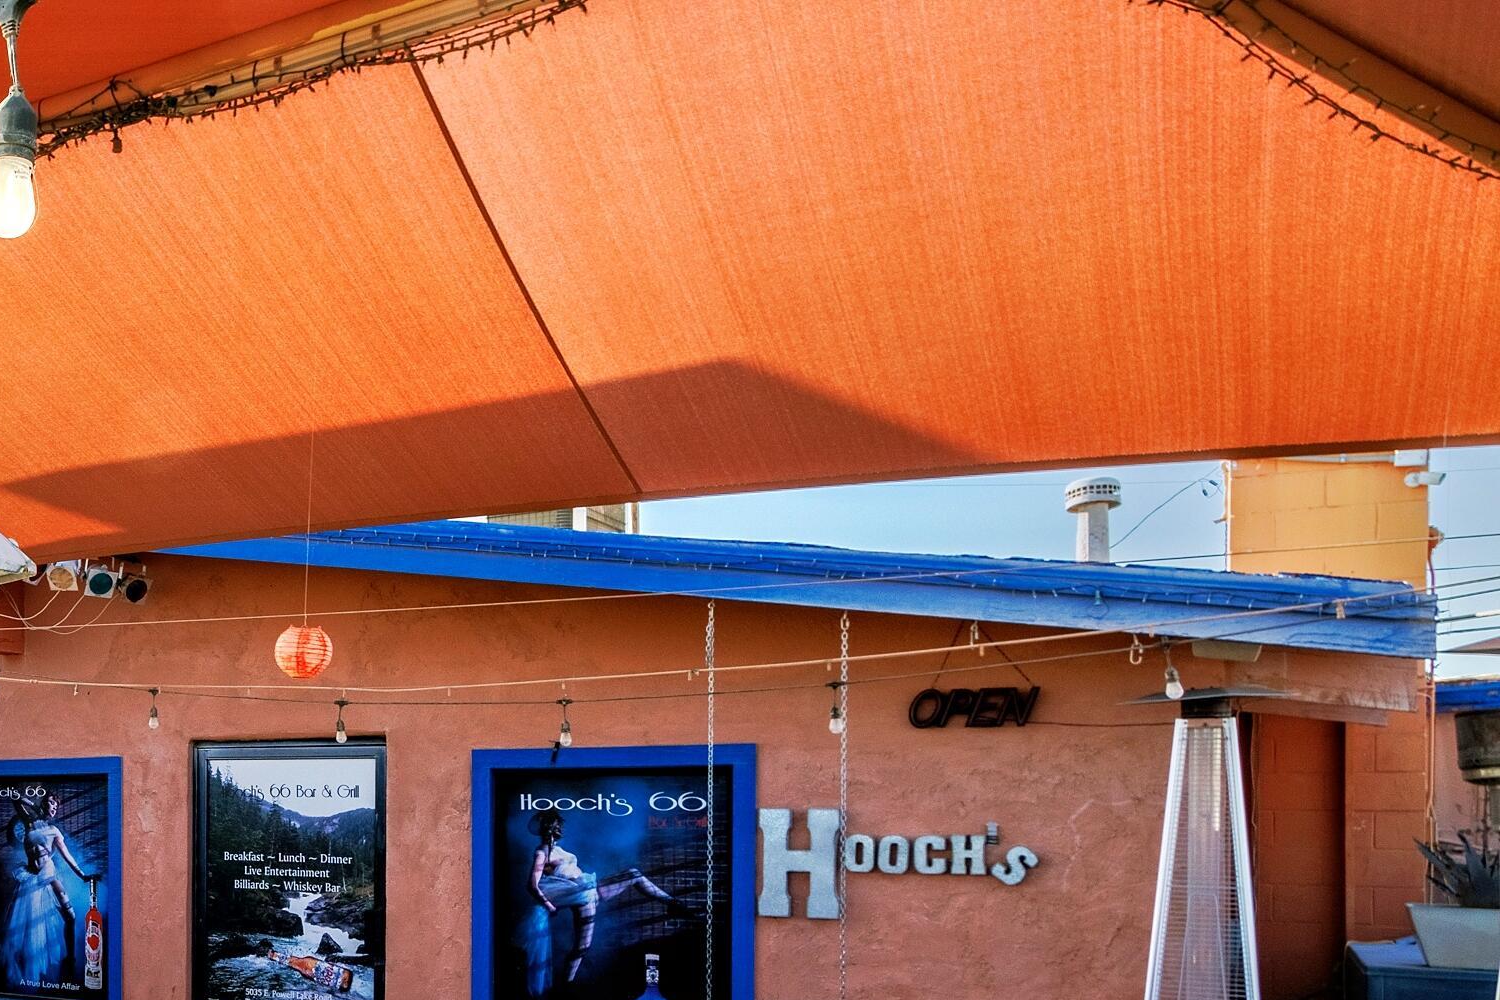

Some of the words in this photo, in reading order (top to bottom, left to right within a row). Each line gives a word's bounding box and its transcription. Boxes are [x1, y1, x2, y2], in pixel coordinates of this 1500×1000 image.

[908, 686, 1041, 729] OPEN
[25, 785, 47, 797] 66
[223, 784, 265, 801] och's
[269, 783, 291, 798] 66
[296, 784, 317, 798] Bar
[322, 784, 332, 798] &
[337, 784, 360, 798] Grill
[520, 793, 633, 817] Hooch's
[648, 791, 707, 812] 66
[223, 851, 265, 862] Breakfast
[278, 852, 306, 863] Lunch
[320, 853, 353, 865] Dinner
[244, 865, 262, 876] Live
[264, 866, 330, 878] Entertainment
[234, 879, 270, 890] Billiards
[283, 880, 323, 893] Whiskey
[325, 882, 341, 893] Bar
[19, 978, 26, 986] A
[26, 979, 41, 987] true
[42, 980, 60, 989] Love
[60, 982, 80, 991] Affair
[245, 988, 263, 997] 5035
[263, 989, 271, 997] E.
[271, 989, 295, 999] Powell
[296, 991, 313, 1000] Lake
